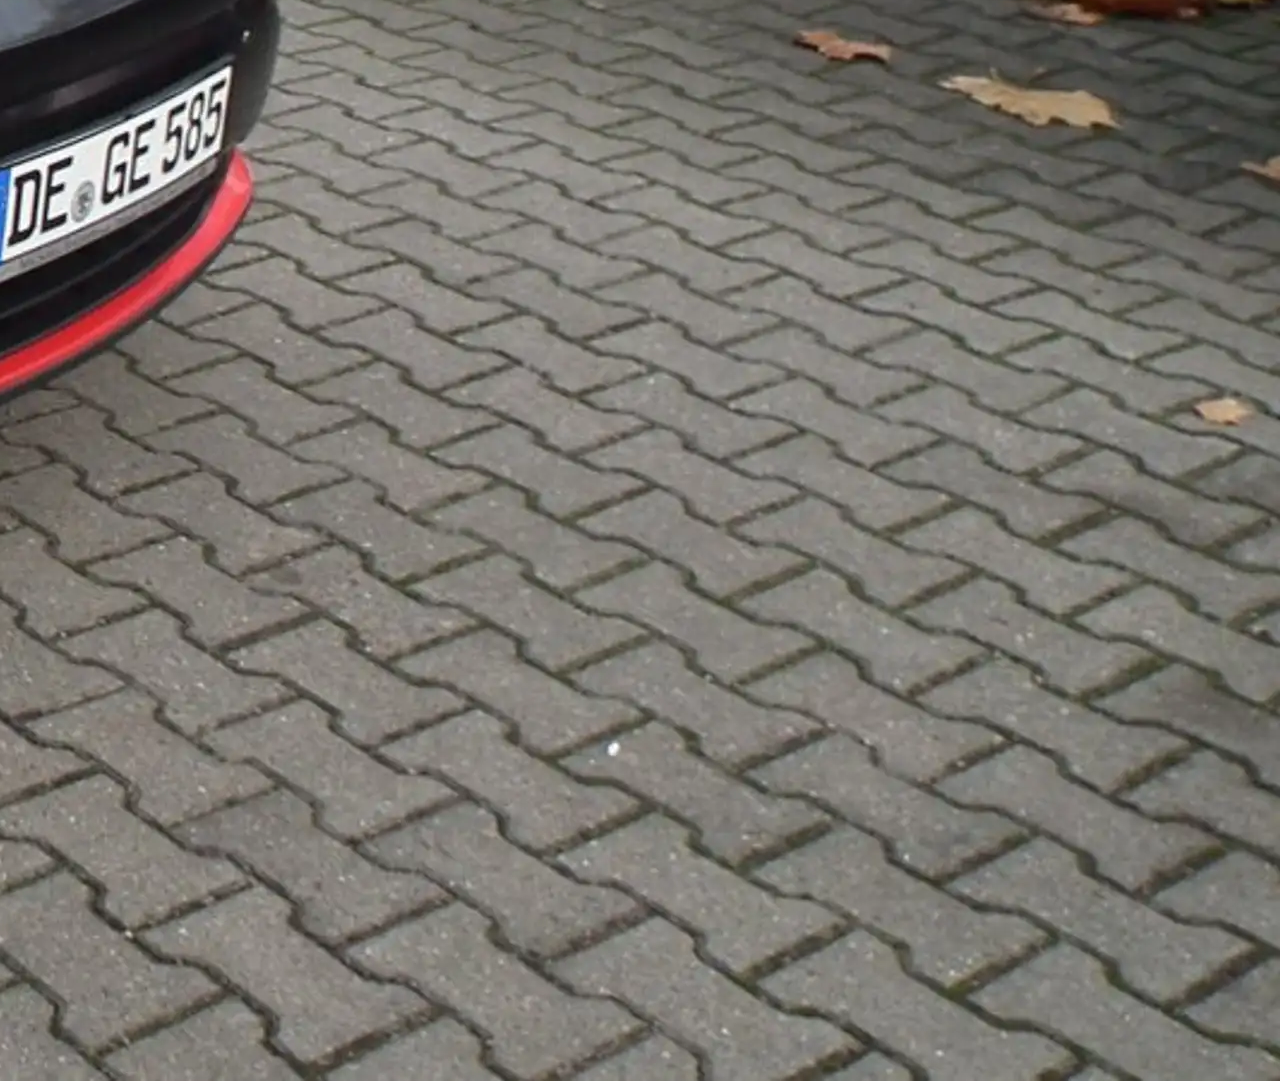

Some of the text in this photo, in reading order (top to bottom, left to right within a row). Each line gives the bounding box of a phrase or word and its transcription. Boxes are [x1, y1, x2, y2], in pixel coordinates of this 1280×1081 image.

[7, 156, 75, 248] DE
[100, 119, 157, 206] GE
[161, 78, 227, 177] 585
